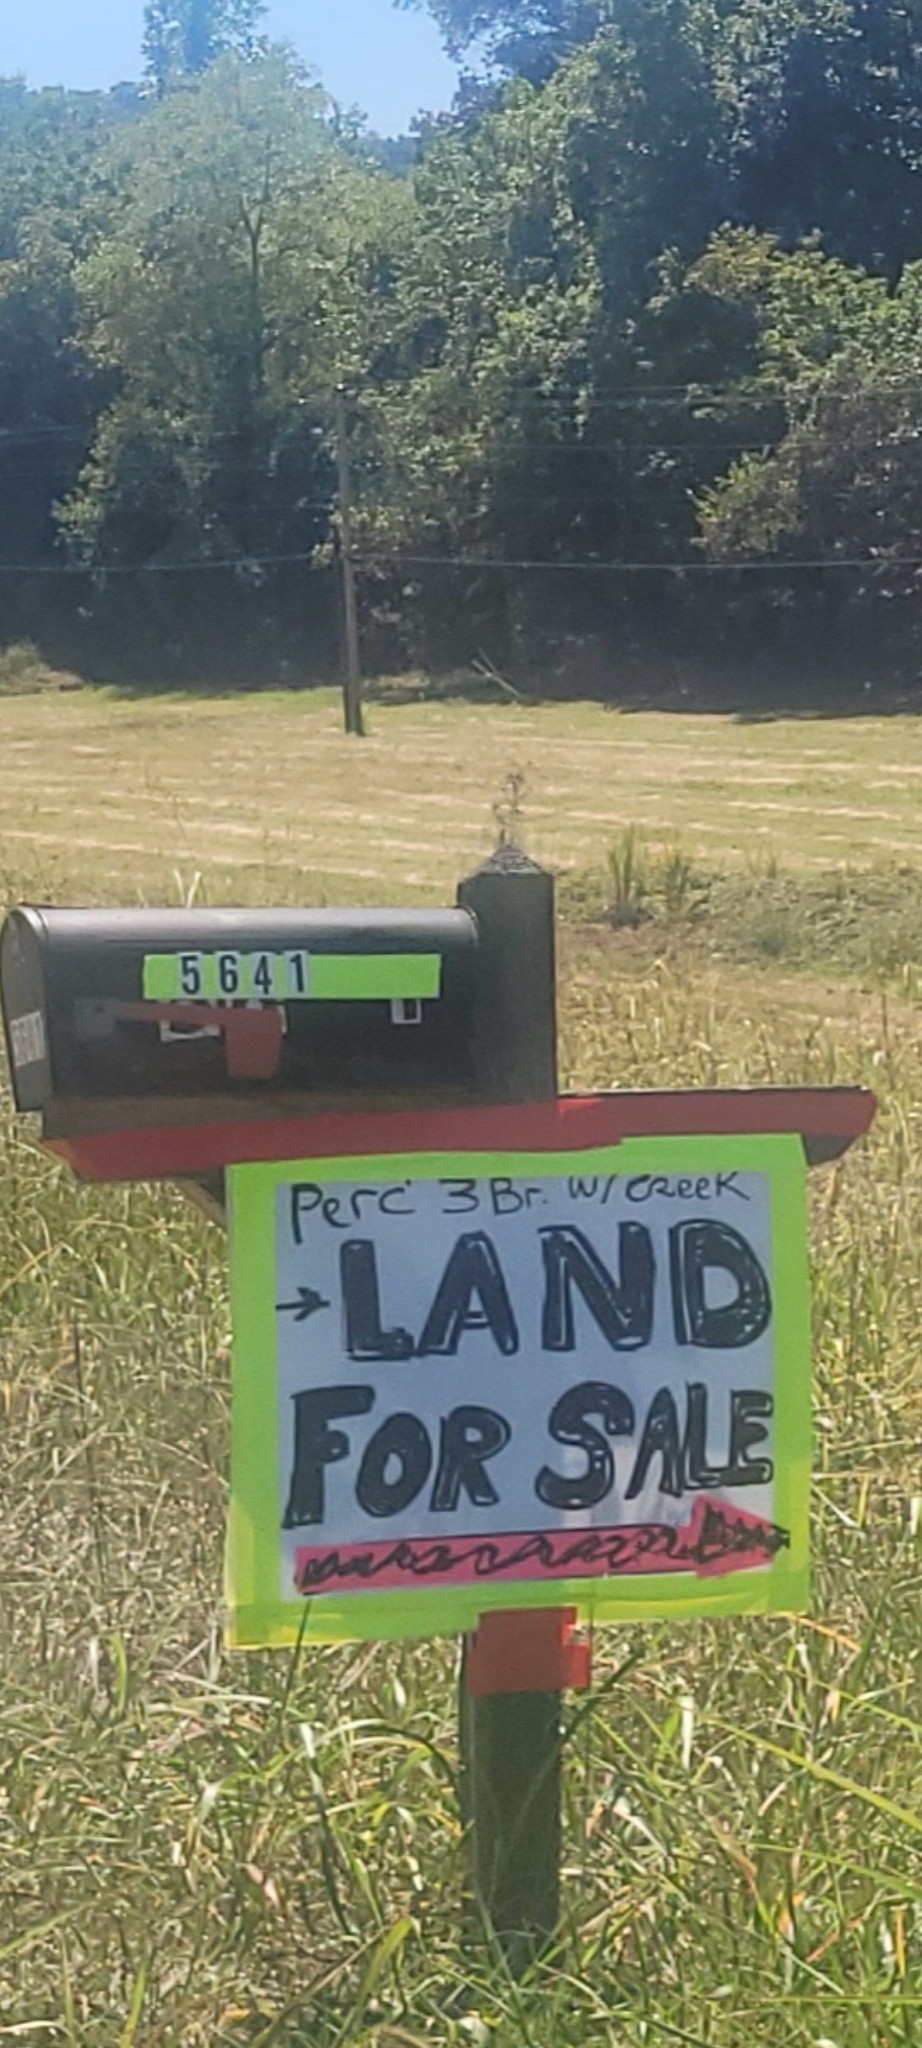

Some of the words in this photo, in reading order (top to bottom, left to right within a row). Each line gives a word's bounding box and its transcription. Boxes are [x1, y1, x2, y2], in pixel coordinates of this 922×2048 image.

[181, 953, 305, 995] 5641
[339, 1218, 772, 1362] LAND
[282, 1384, 511, 1530] FOR
[534, 1380, 775, 1510] SALE
